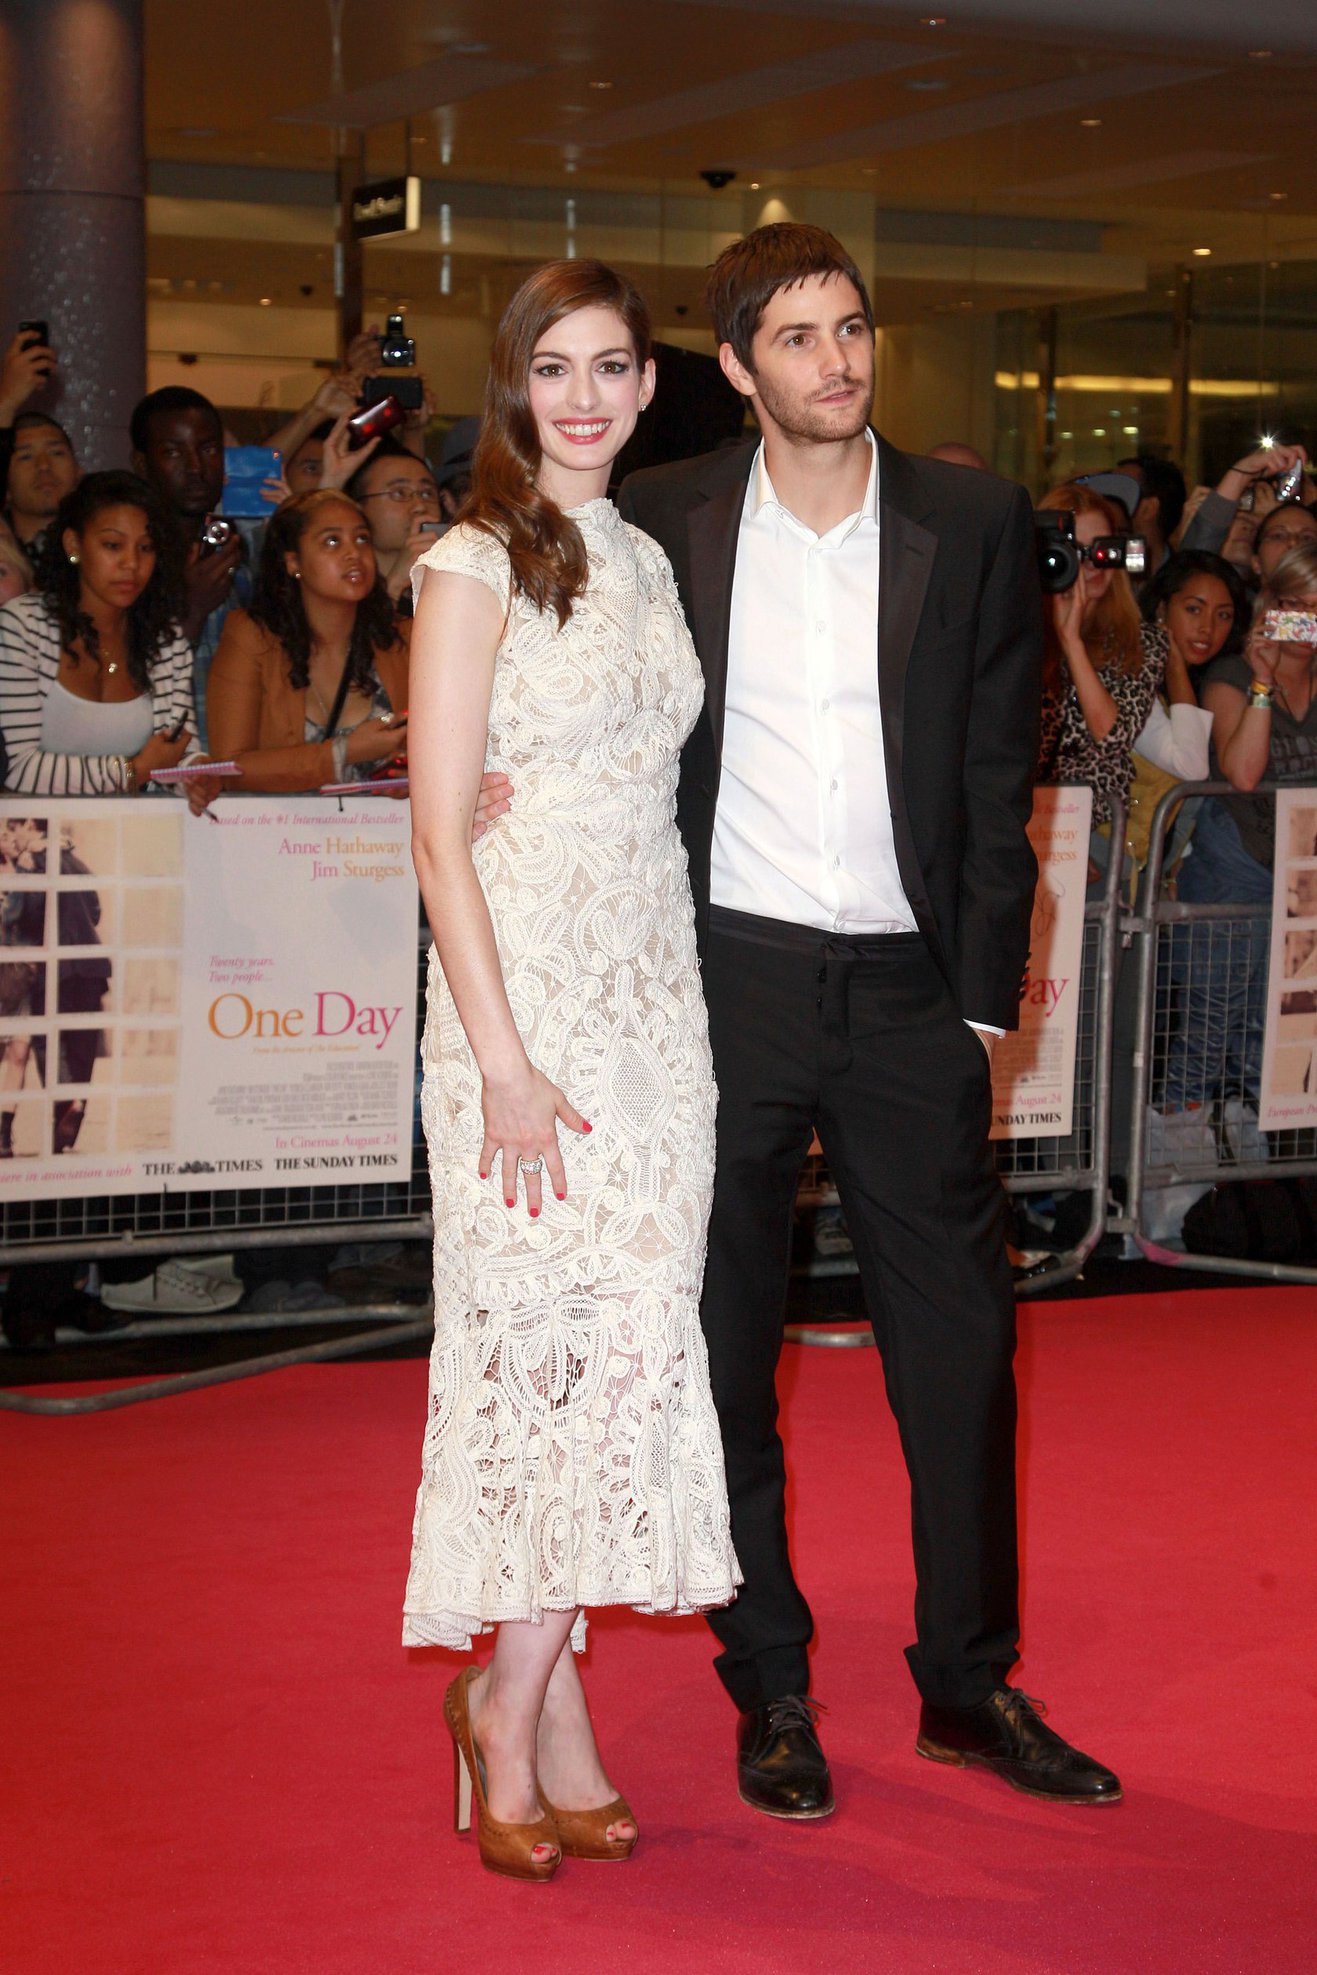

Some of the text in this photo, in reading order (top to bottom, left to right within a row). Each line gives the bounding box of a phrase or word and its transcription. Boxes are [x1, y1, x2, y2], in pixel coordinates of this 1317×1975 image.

[241, 815, 254, 824] on
[258, 813, 272, 824] the
[276, 813, 289, 824] #1
[292, 812, 358, 824] International
[361, 812, 403, 824] Bestseller
[278, 837, 403, 858] Anne Hathaway
[310, 861, 404, 881] Jim Sturgess
[209, 955, 245, 968] Twenty
[208, 971, 231, 983] Two
[1022, 973, 1071, 1018] ay
[207, 991, 403, 1050] One Day
[1015, 1093, 1048, 1109] August
[992, 1111, 1063, 1126] UNDAY TIMES
[275, 1133, 398, 1151] In Cinemas August 24
[143, 1158, 263, 1176] THE TIMES
[274, 1154, 398, 1170] THE SUNDAY TIMES
[106, 1165, 134, 1177] with
